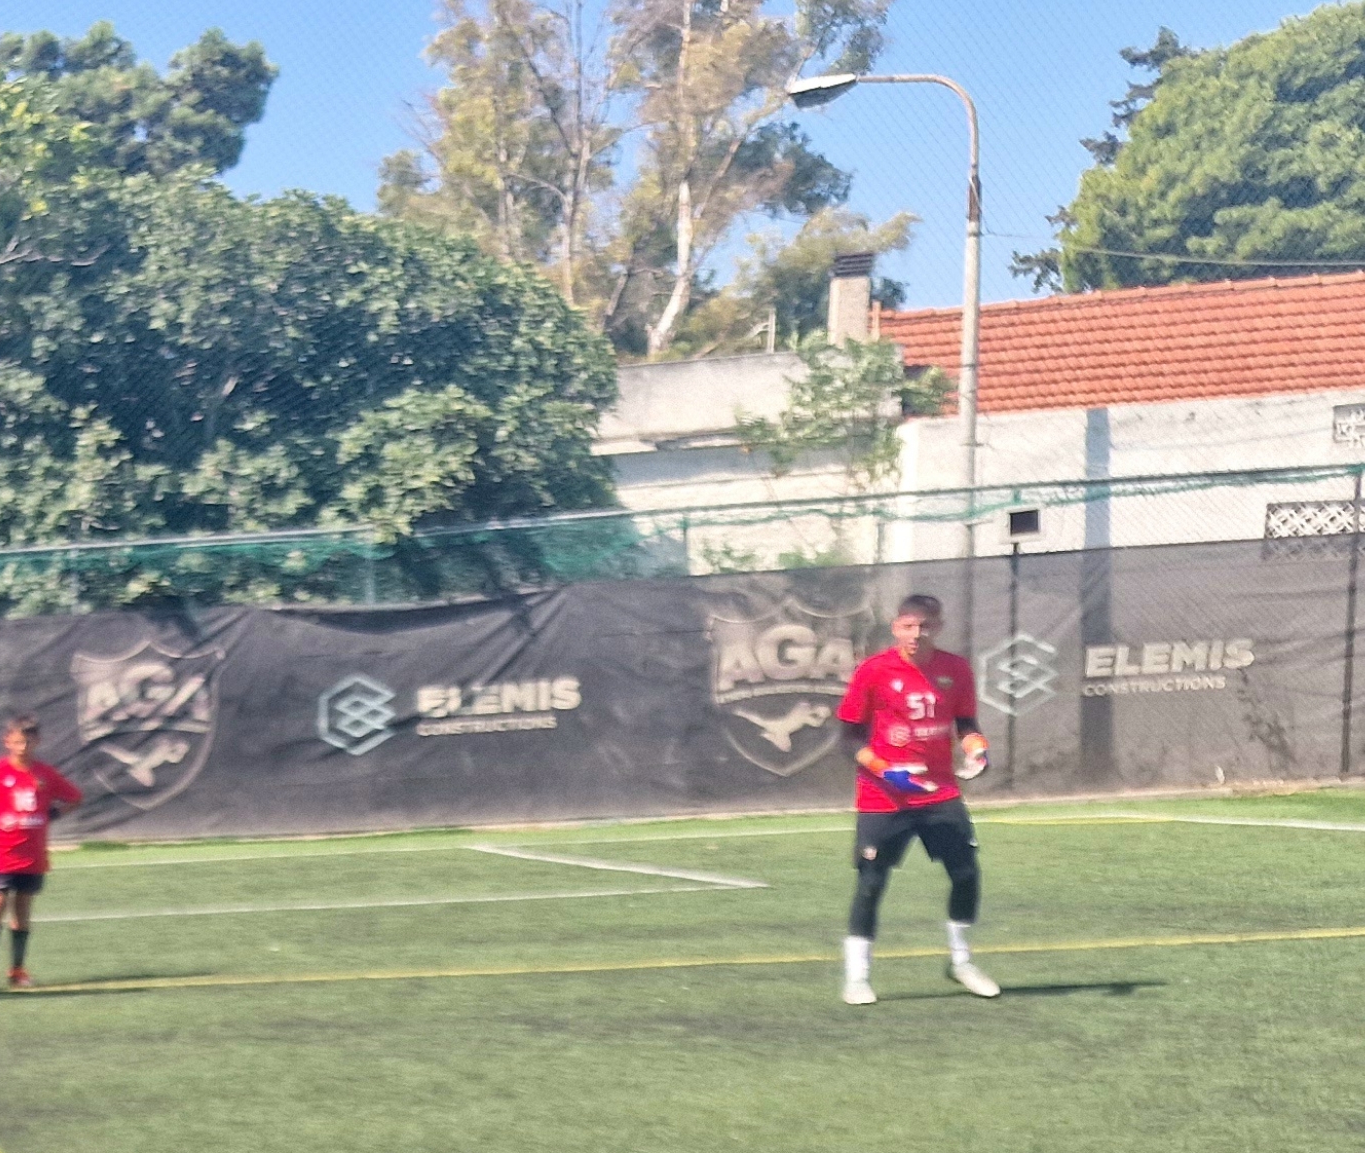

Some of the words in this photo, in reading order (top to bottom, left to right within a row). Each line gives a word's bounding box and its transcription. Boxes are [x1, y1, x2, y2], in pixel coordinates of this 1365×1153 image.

[1084, 637, 1256, 678] ELEMIS
[1083, 675, 1227, 697] CONSTRUCTIONS
[906, 692, 937, 720] 51
